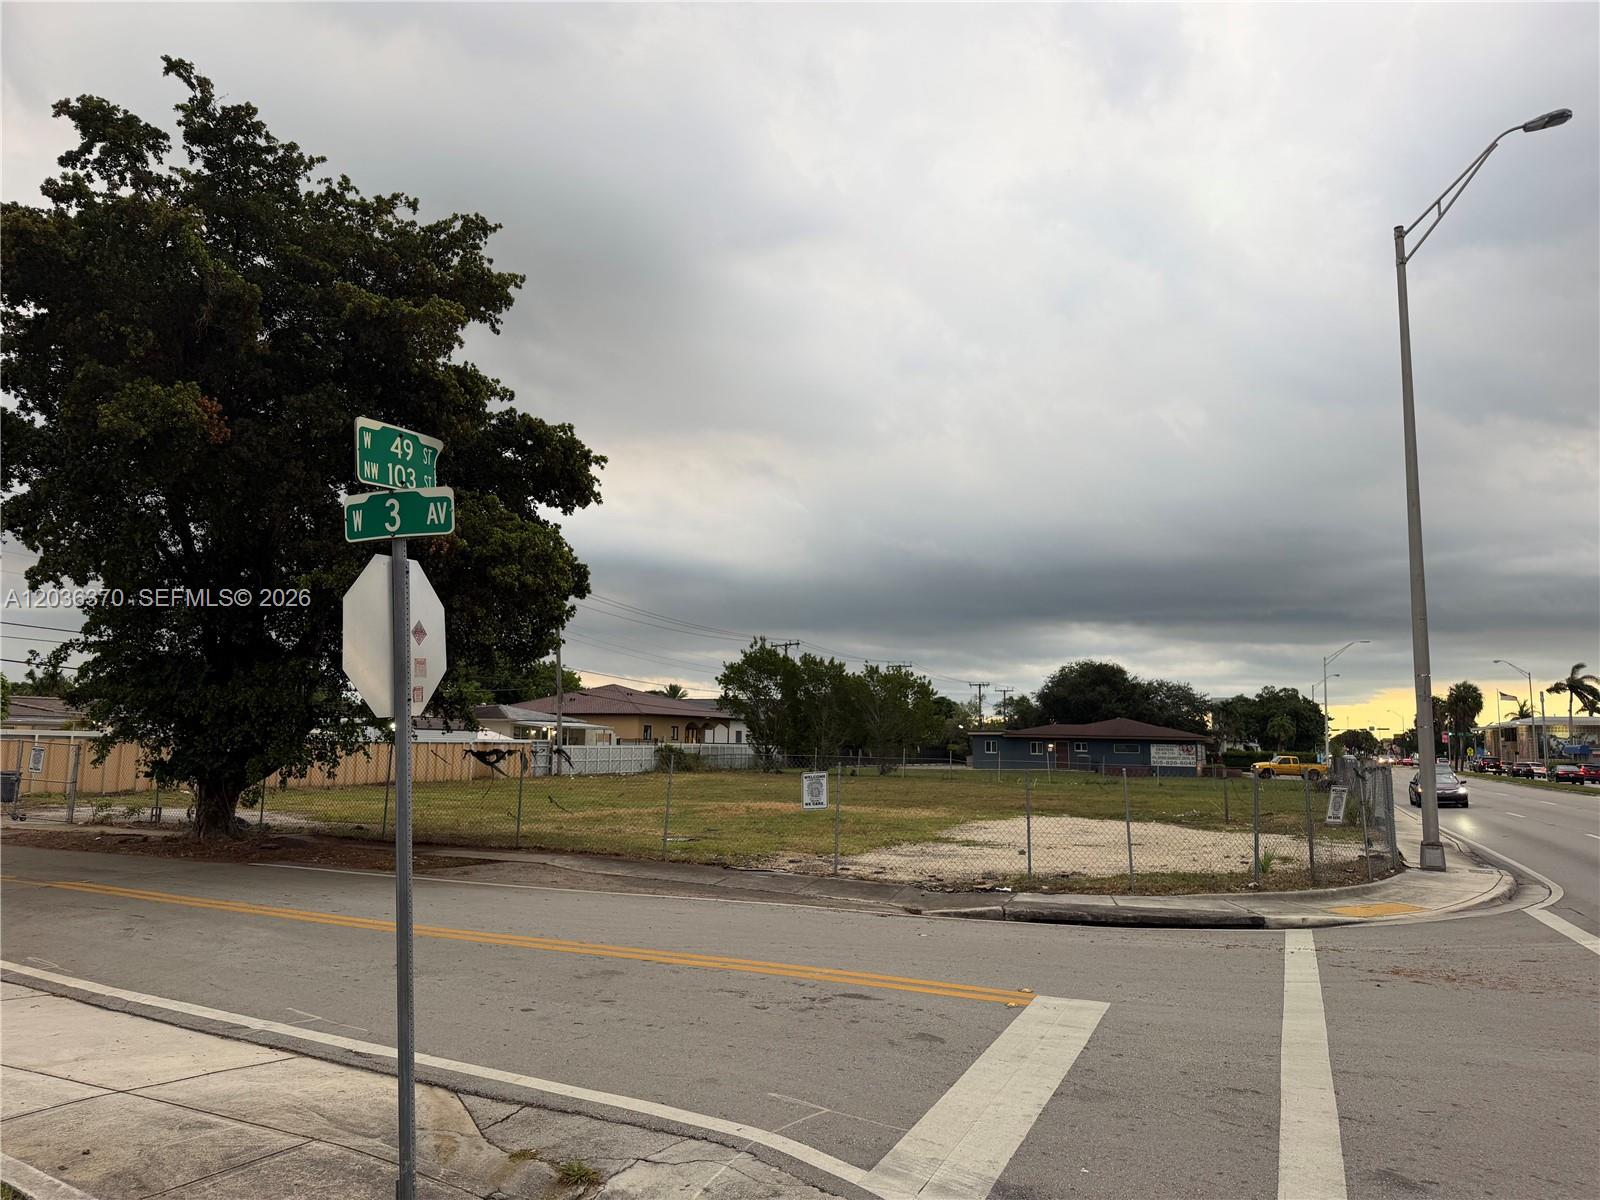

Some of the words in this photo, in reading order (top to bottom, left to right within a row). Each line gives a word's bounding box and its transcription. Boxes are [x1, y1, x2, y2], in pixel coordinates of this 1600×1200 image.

[363, 431, 372, 449] W
[390, 437, 413, 461] 49
[422, 447, 433, 465] ST
[364, 461, 379, 481] NW
[387, 463, 416, 489] 103
[352, 510, 363, 532] W
[384, 498, 401, 532] 3
[427, 502, 447, 525] AV
